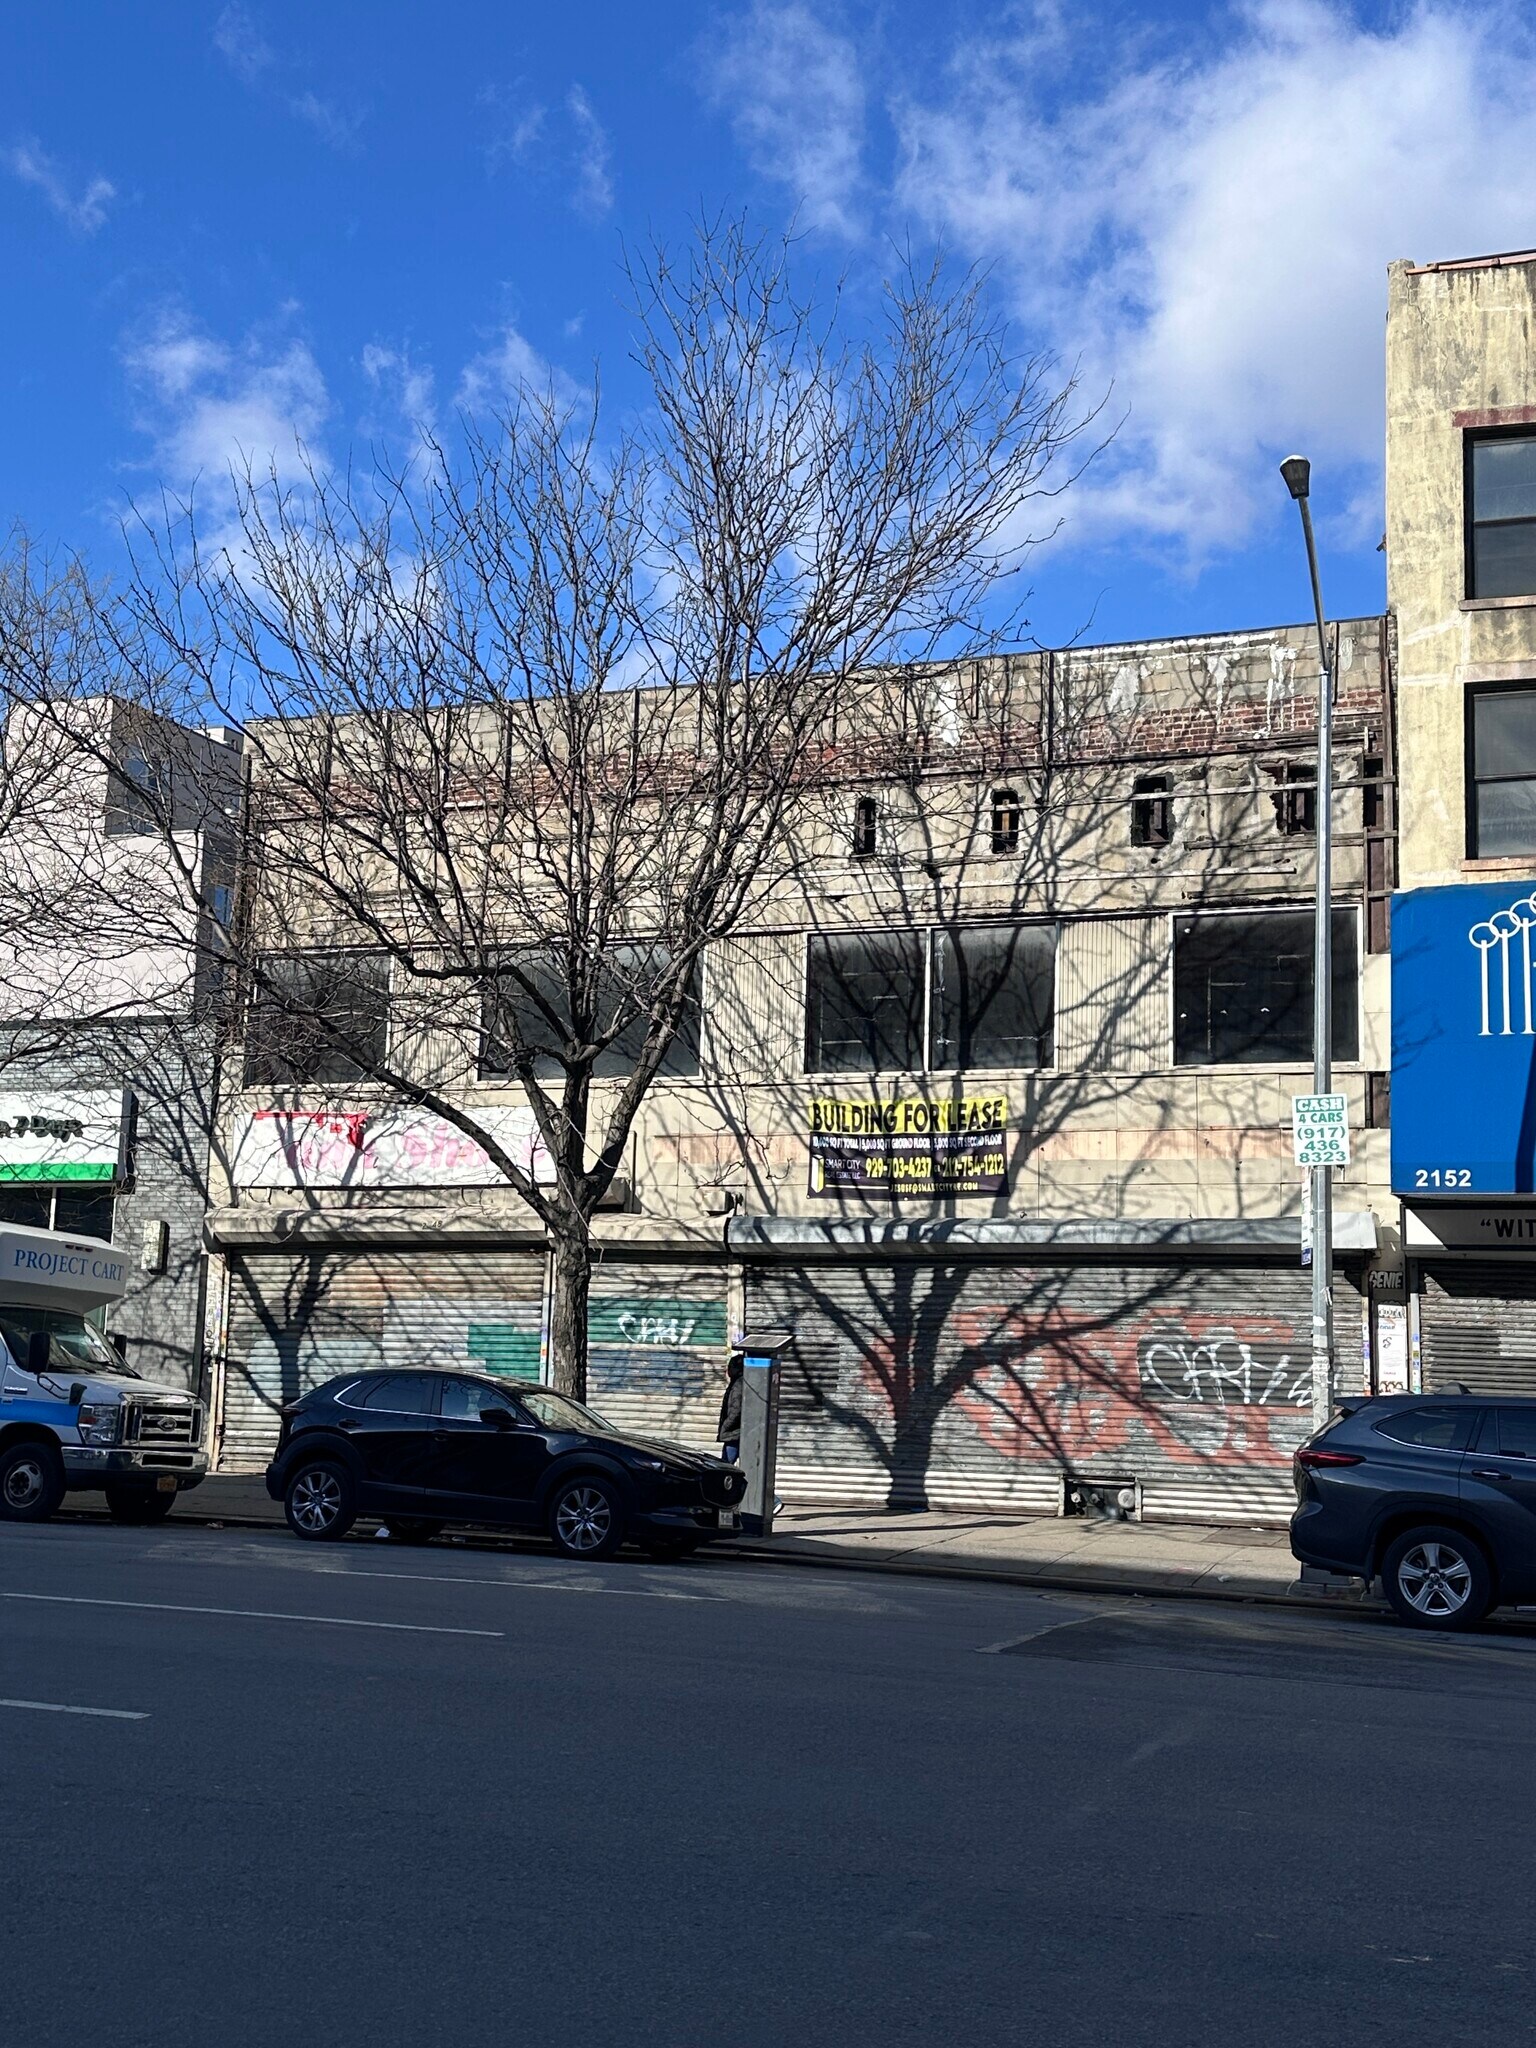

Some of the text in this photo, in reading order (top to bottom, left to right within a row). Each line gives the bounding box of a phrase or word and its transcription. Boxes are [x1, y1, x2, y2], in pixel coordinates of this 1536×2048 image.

[813, 1100, 1003, 1132] BUILDING FOR LEASE
[1299, 1112, 1343, 1124] 4 CARS
[1297, 1126, 1346, 1140] (917)
[913, 1137, 930, 1149] FLOOR
[984, 1133, 1002, 1145] FLOOR
[1304, 1140, 1340, 1151] 436
[825, 1159, 860, 1169] SMART CITY
[1299, 1151, 1346, 1163] 8323
[865, 1157, 931, 1178] 929-703-4237
[942, 1153, 1005, 1178] 212-754-1212
[1415, 1169, 1472, 1187] 2152
[13, 1249, 124, 1281] PROJECT CART
